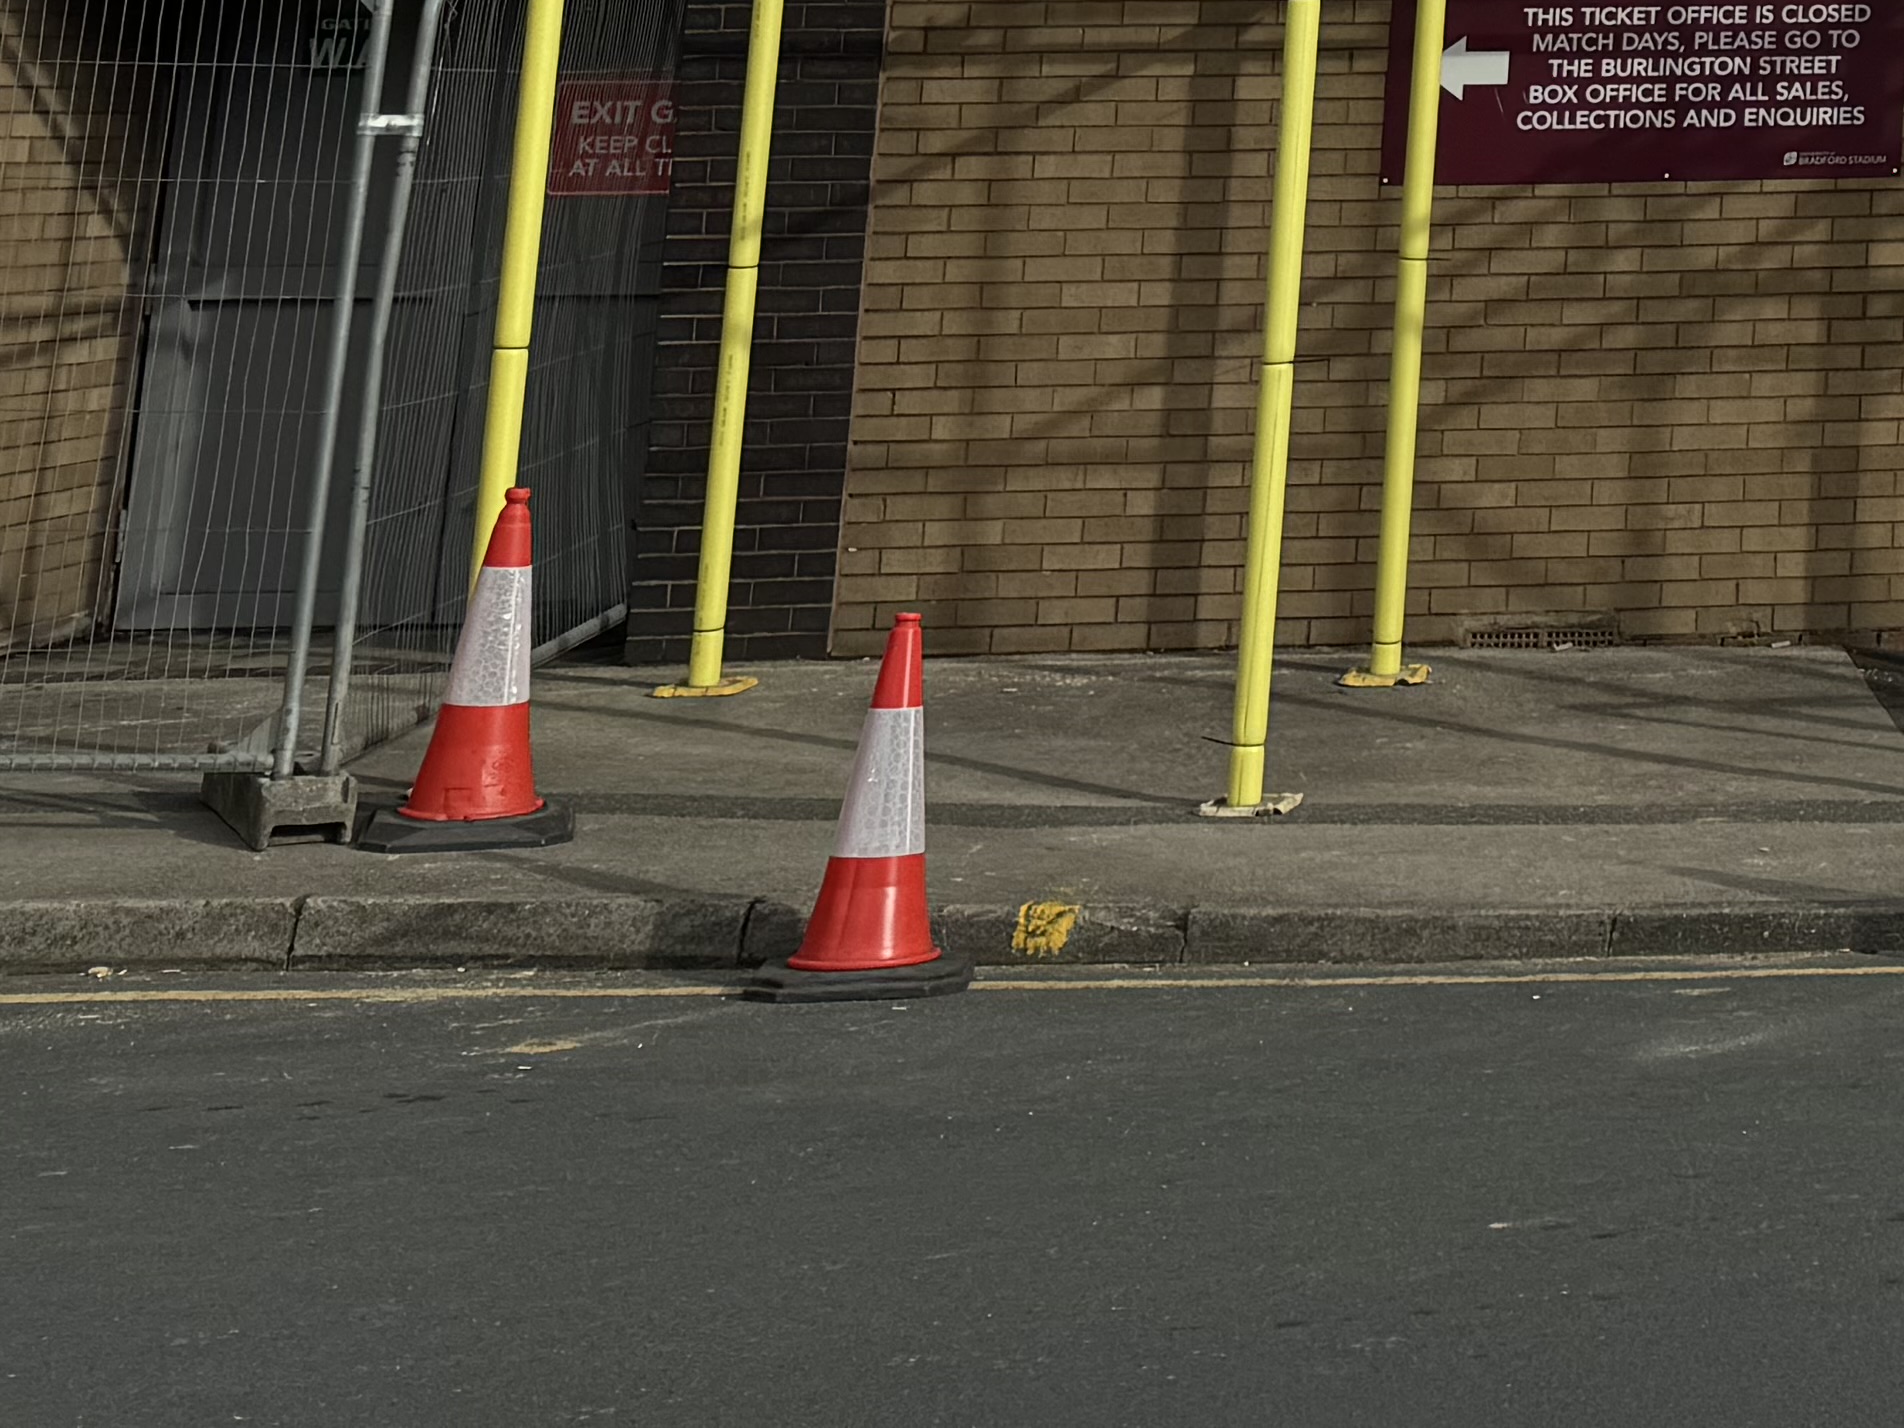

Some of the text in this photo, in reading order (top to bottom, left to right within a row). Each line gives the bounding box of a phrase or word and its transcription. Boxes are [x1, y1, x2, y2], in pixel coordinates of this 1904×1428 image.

[1524, 4, 1871, 27] THIS TICKET OFFICE IS CLOSED
[1532, 29, 1860, 54] MATCH DAYS, PLEASE GO TO
[1548, 55, 1841, 78] THE BURLINGTON STREET
[1529, 81, 1848, 104] BOX OFFICE FOR ALL SALES,
[571, 101, 641, 124] EXIT
[1517, 106, 1865, 131] COLLECTIONS AND ENQUIRIES
[579, 136, 638, 154] KEEP
[568, 159, 599, 177] AT
[605, 159, 646, 177] ALL
